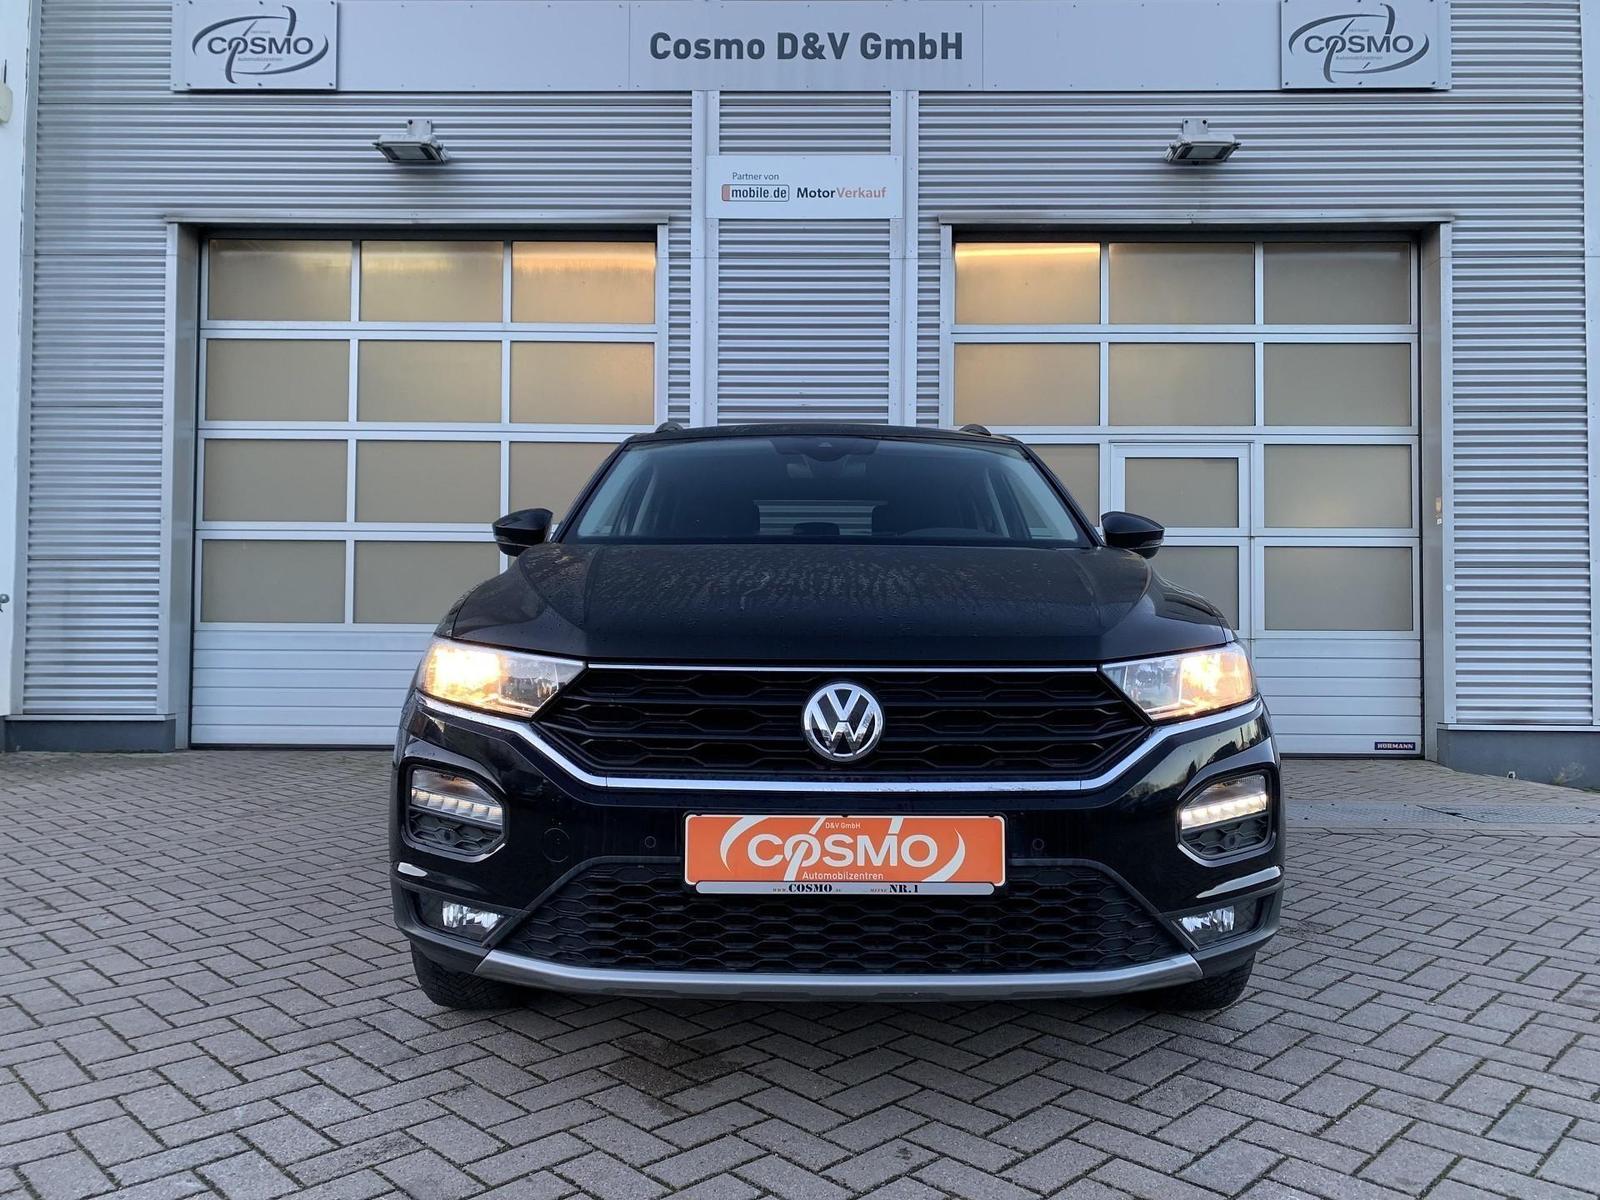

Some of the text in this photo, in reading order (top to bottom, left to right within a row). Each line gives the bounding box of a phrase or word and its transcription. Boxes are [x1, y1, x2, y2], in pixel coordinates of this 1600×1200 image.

[207, 36, 313, 55] COSMO
[650, 31, 963, 60] Cosmo D&V GmbH
[1304, 35, 1414, 53] COSMO
[732, 172, 762, 181] Partner
[731, 186, 787, 199] mobile.de
[840, 821, 862, 829] GmbH
[747, 833, 938, 868] COSMO
[802, 871, 884, 881] Automobilzentren
